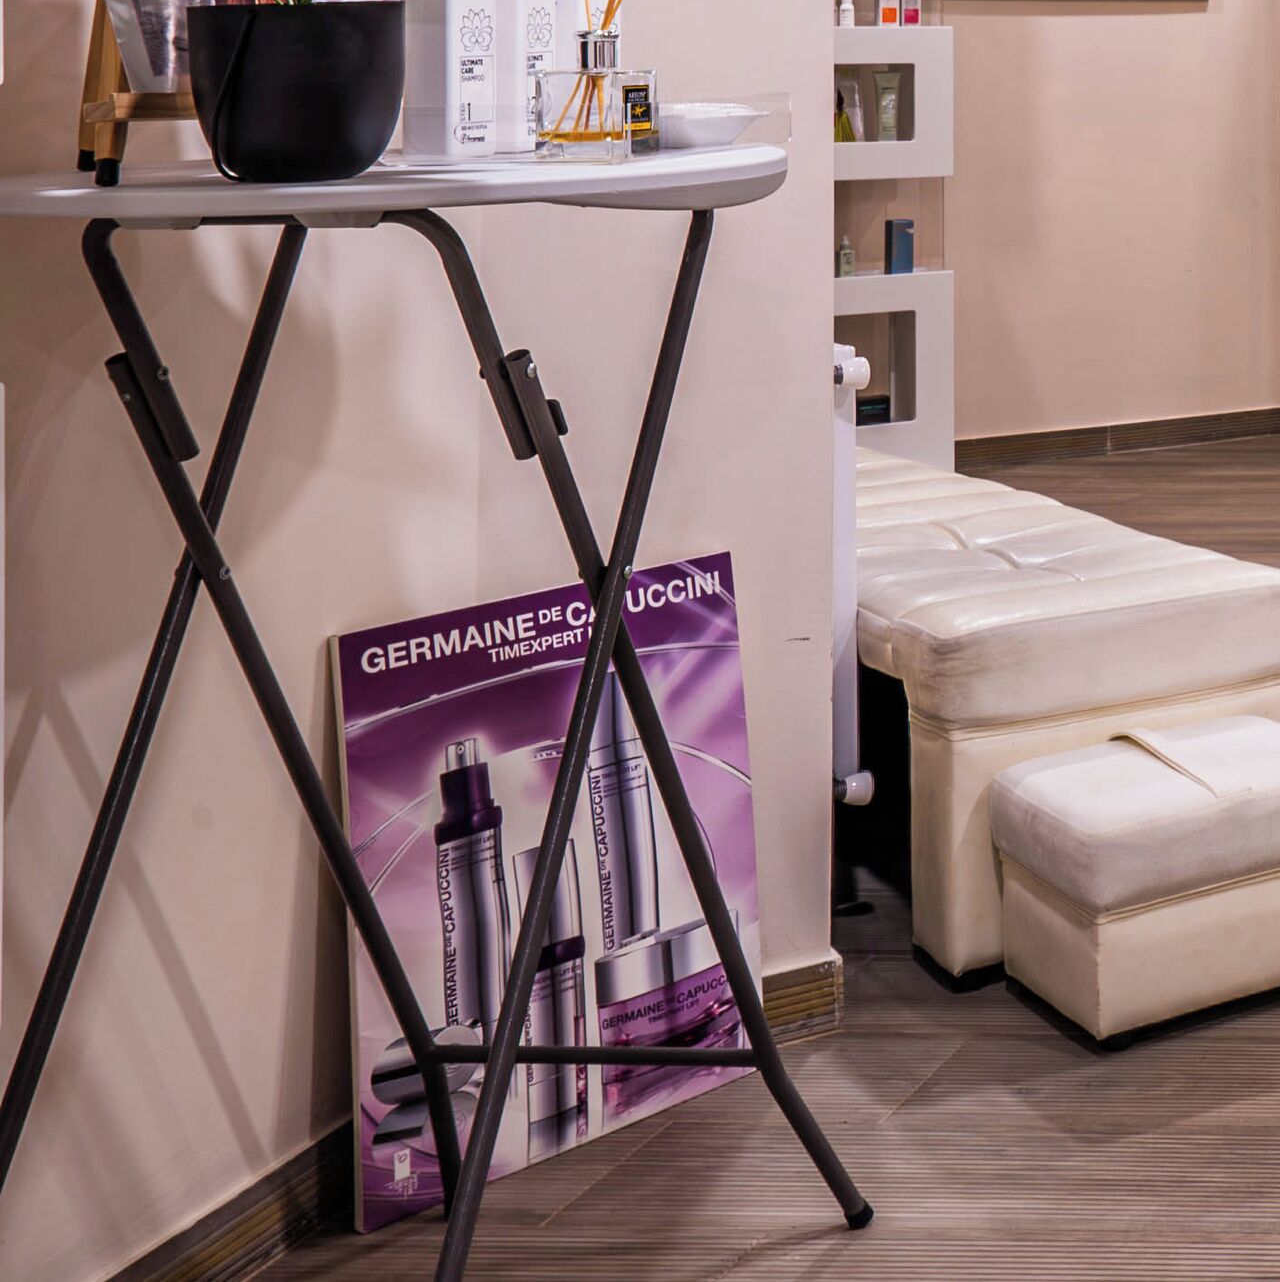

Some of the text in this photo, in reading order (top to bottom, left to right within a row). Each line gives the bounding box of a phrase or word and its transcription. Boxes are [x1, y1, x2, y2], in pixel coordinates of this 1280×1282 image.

[461, 59, 483, 67] ULTIMATE
[360, 571, 721, 675] GERMAINE DE CUCCINI
[488, 628, 584, 663] TIMEXPERT
[592, 775, 609, 858] CAPUCCINI
[439, 849, 456, 932] CAPUCCINI
[602, 870, 614, 950] GERMAINE
[602, 1000, 665, 1030] GERMAINE
